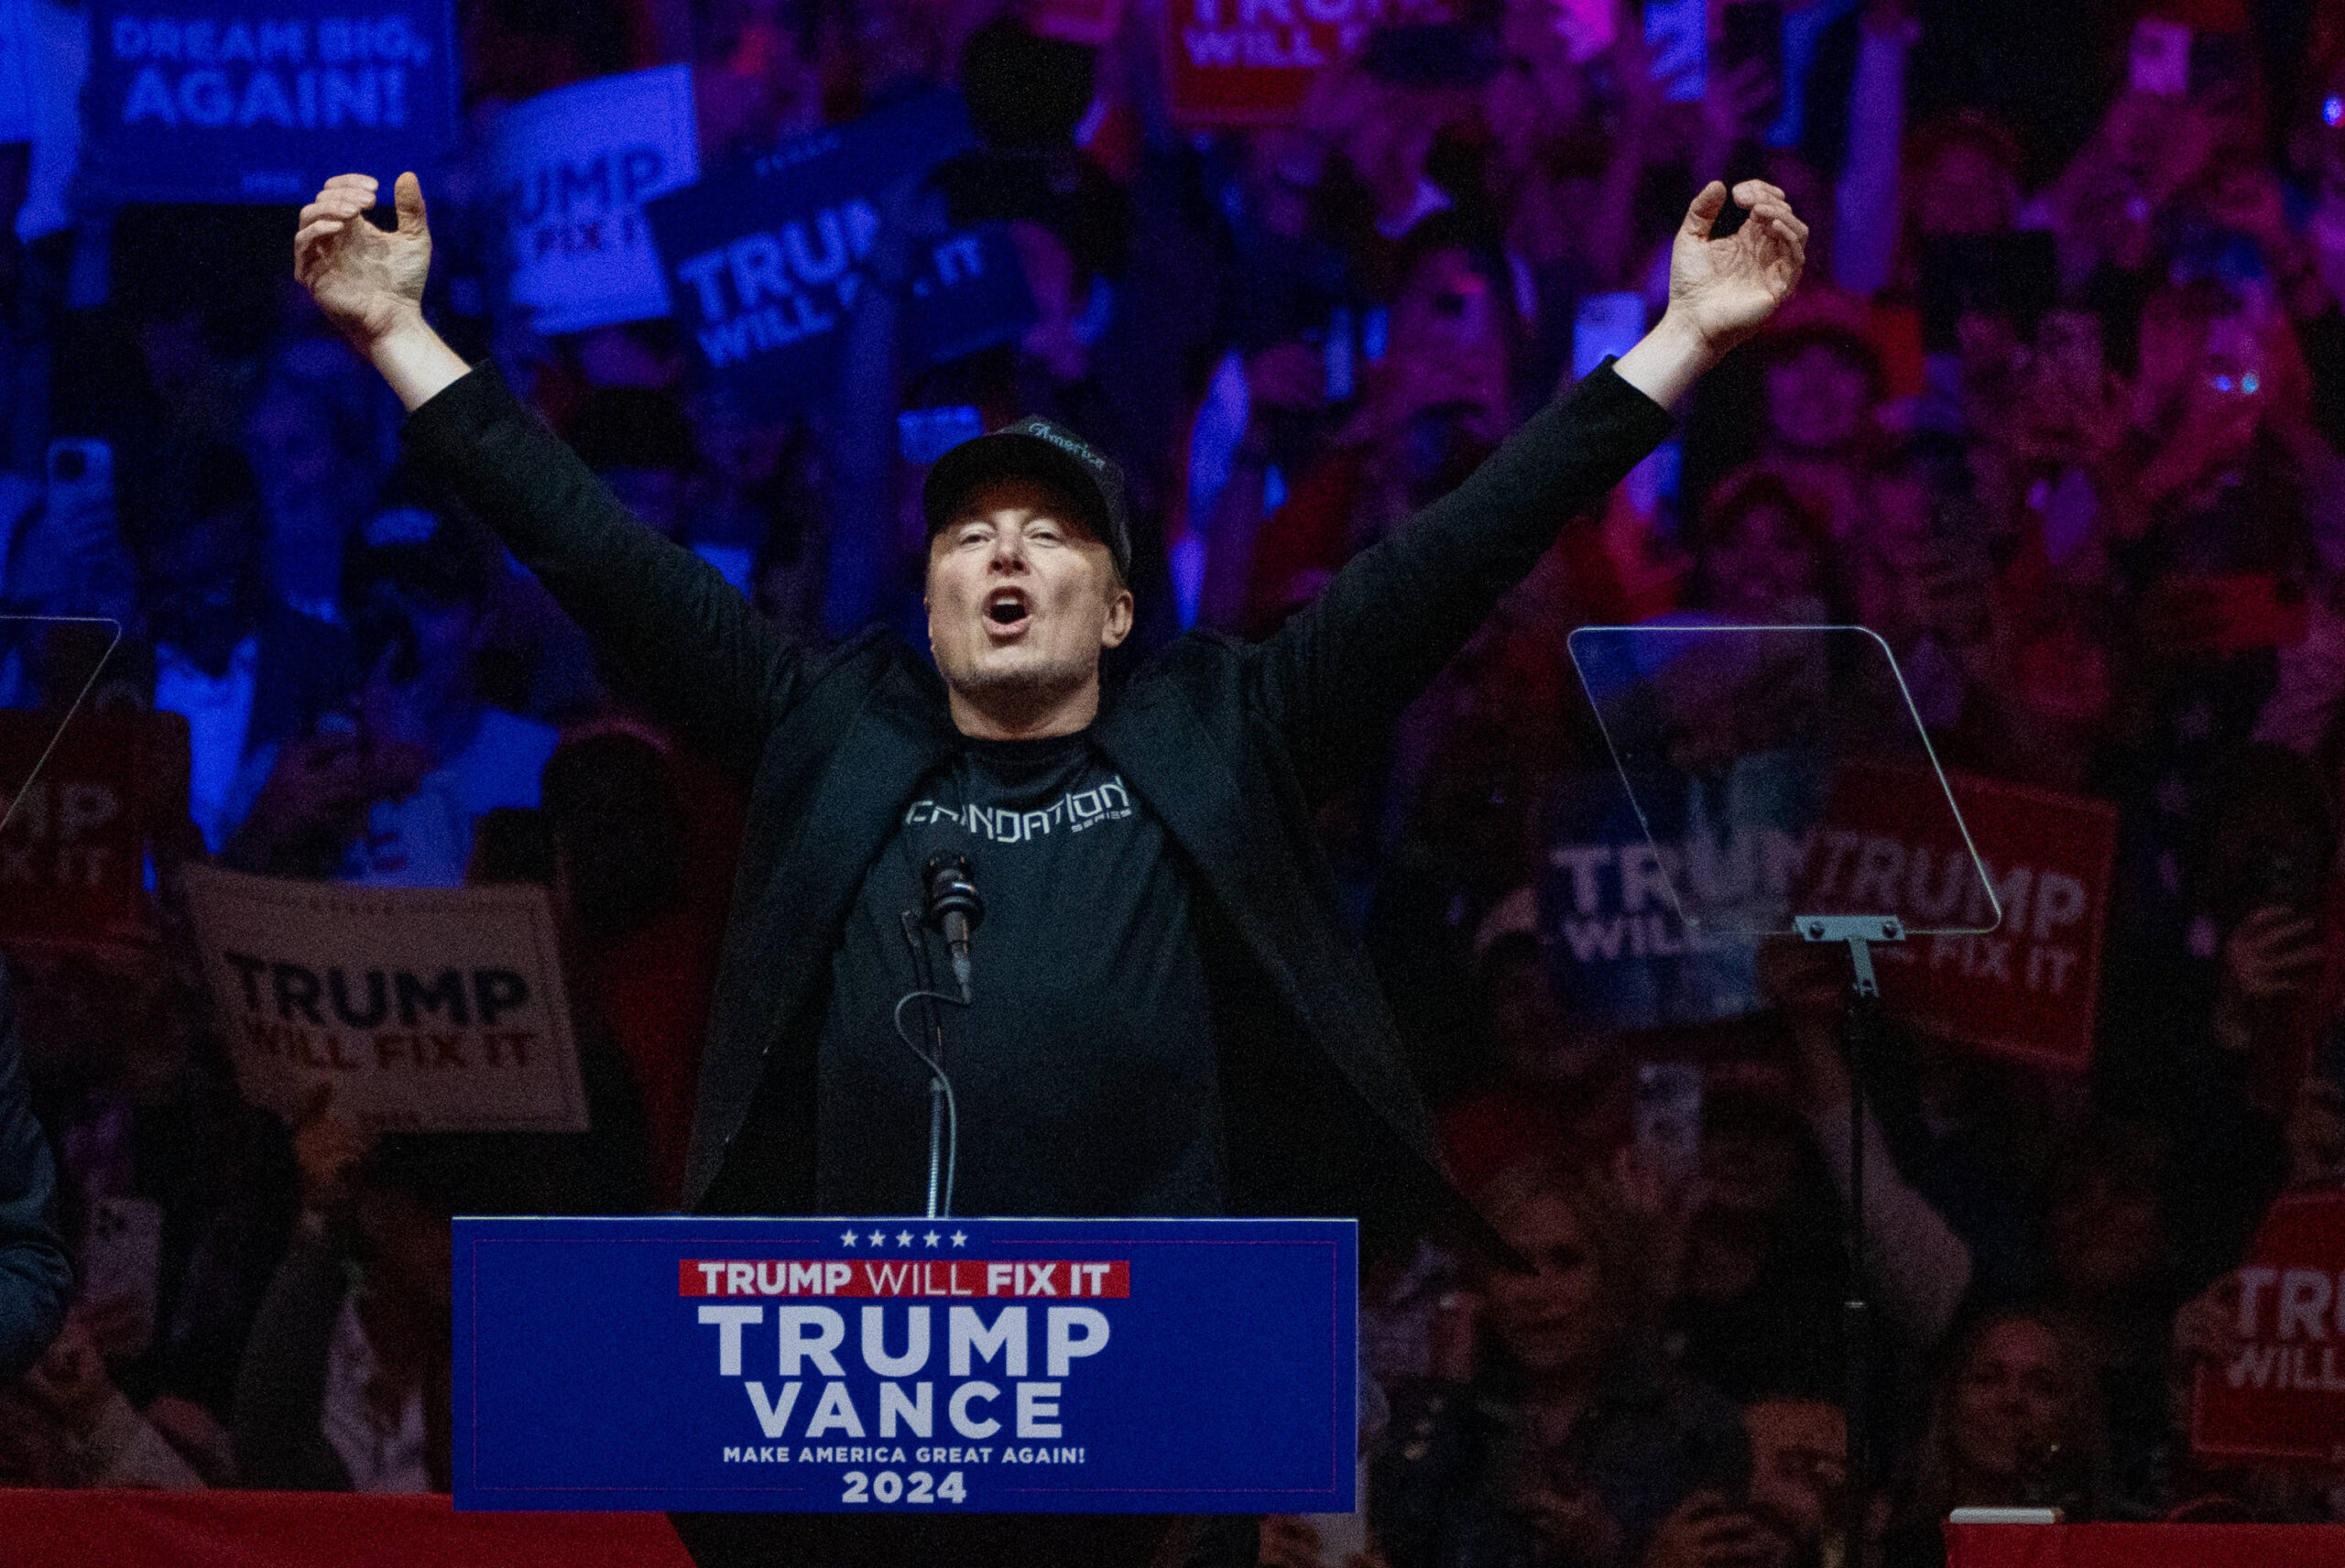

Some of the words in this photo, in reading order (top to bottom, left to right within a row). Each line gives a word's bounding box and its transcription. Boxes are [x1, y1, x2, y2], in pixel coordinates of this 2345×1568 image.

[112, 16, 306, 60] DREAM
[122, 67, 407, 130] AGAIN!
[509, 147, 666, 227] UMP
[676, 195, 878, 322] TRU
[1823, 828, 2088, 942] TRUMP
[223, 949, 529, 1029] TRUMP
[2025, 944, 2079, 996] IT
[236, 1013, 360, 1072] WILL
[376, 1032, 466, 1070] FIX
[487, 1030, 537, 1067] IT
[697, 1262, 852, 1295] TRUMP
[864, 1263, 973, 1296] WILL
[987, 1263, 1057, 1296] FIX
[1070, 1263, 1111, 1296] IT
[2239, 1266, 2345, 1341] TR
[697, 1305, 1111, 1377] TRUMP
[745, 1380, 1063, 1439] VANCE
[723, 1446, 790, 1464] MAKE
[799, 1446, 907, 1464] AMERICA
[915, 1446, 993, 1464] GREAT
[1000, 1446, 1085, 1464] AGAIN!
[841, 1471, 967, 1504] 2024
